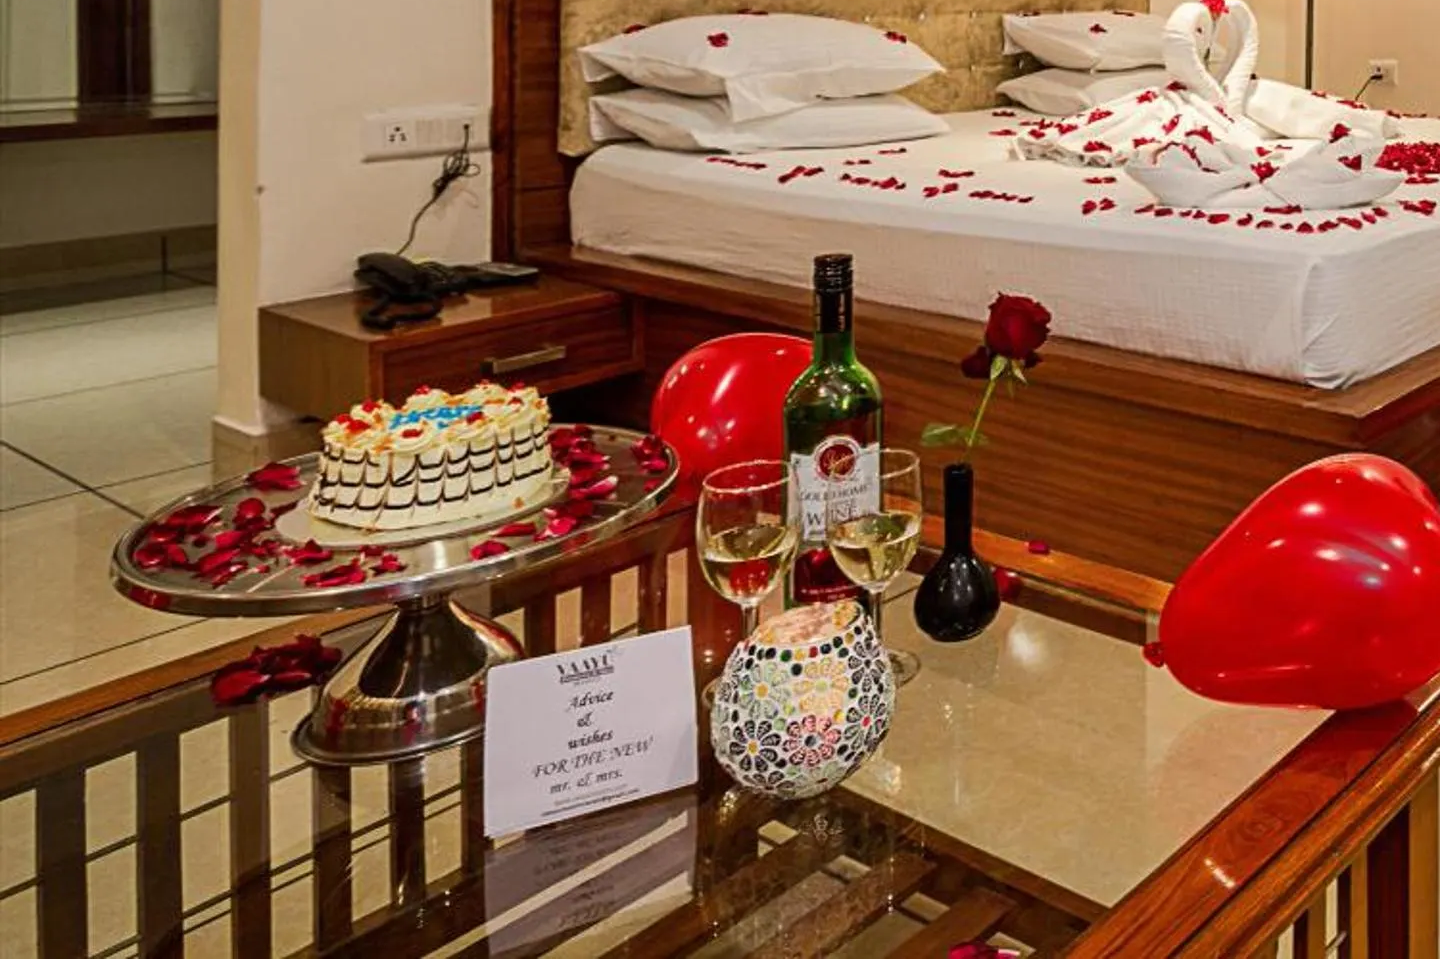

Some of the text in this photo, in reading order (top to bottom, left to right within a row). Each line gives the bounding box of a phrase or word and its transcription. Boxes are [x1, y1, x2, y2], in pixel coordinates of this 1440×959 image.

[568, 690, 614, 709] Advice
[568, 729, 614, 750] wishes
[533, 736, 654, 778] FOR THE NEW
[549, 781, 571, 794] mr.
[595, 770, 623, 783] mrs.
